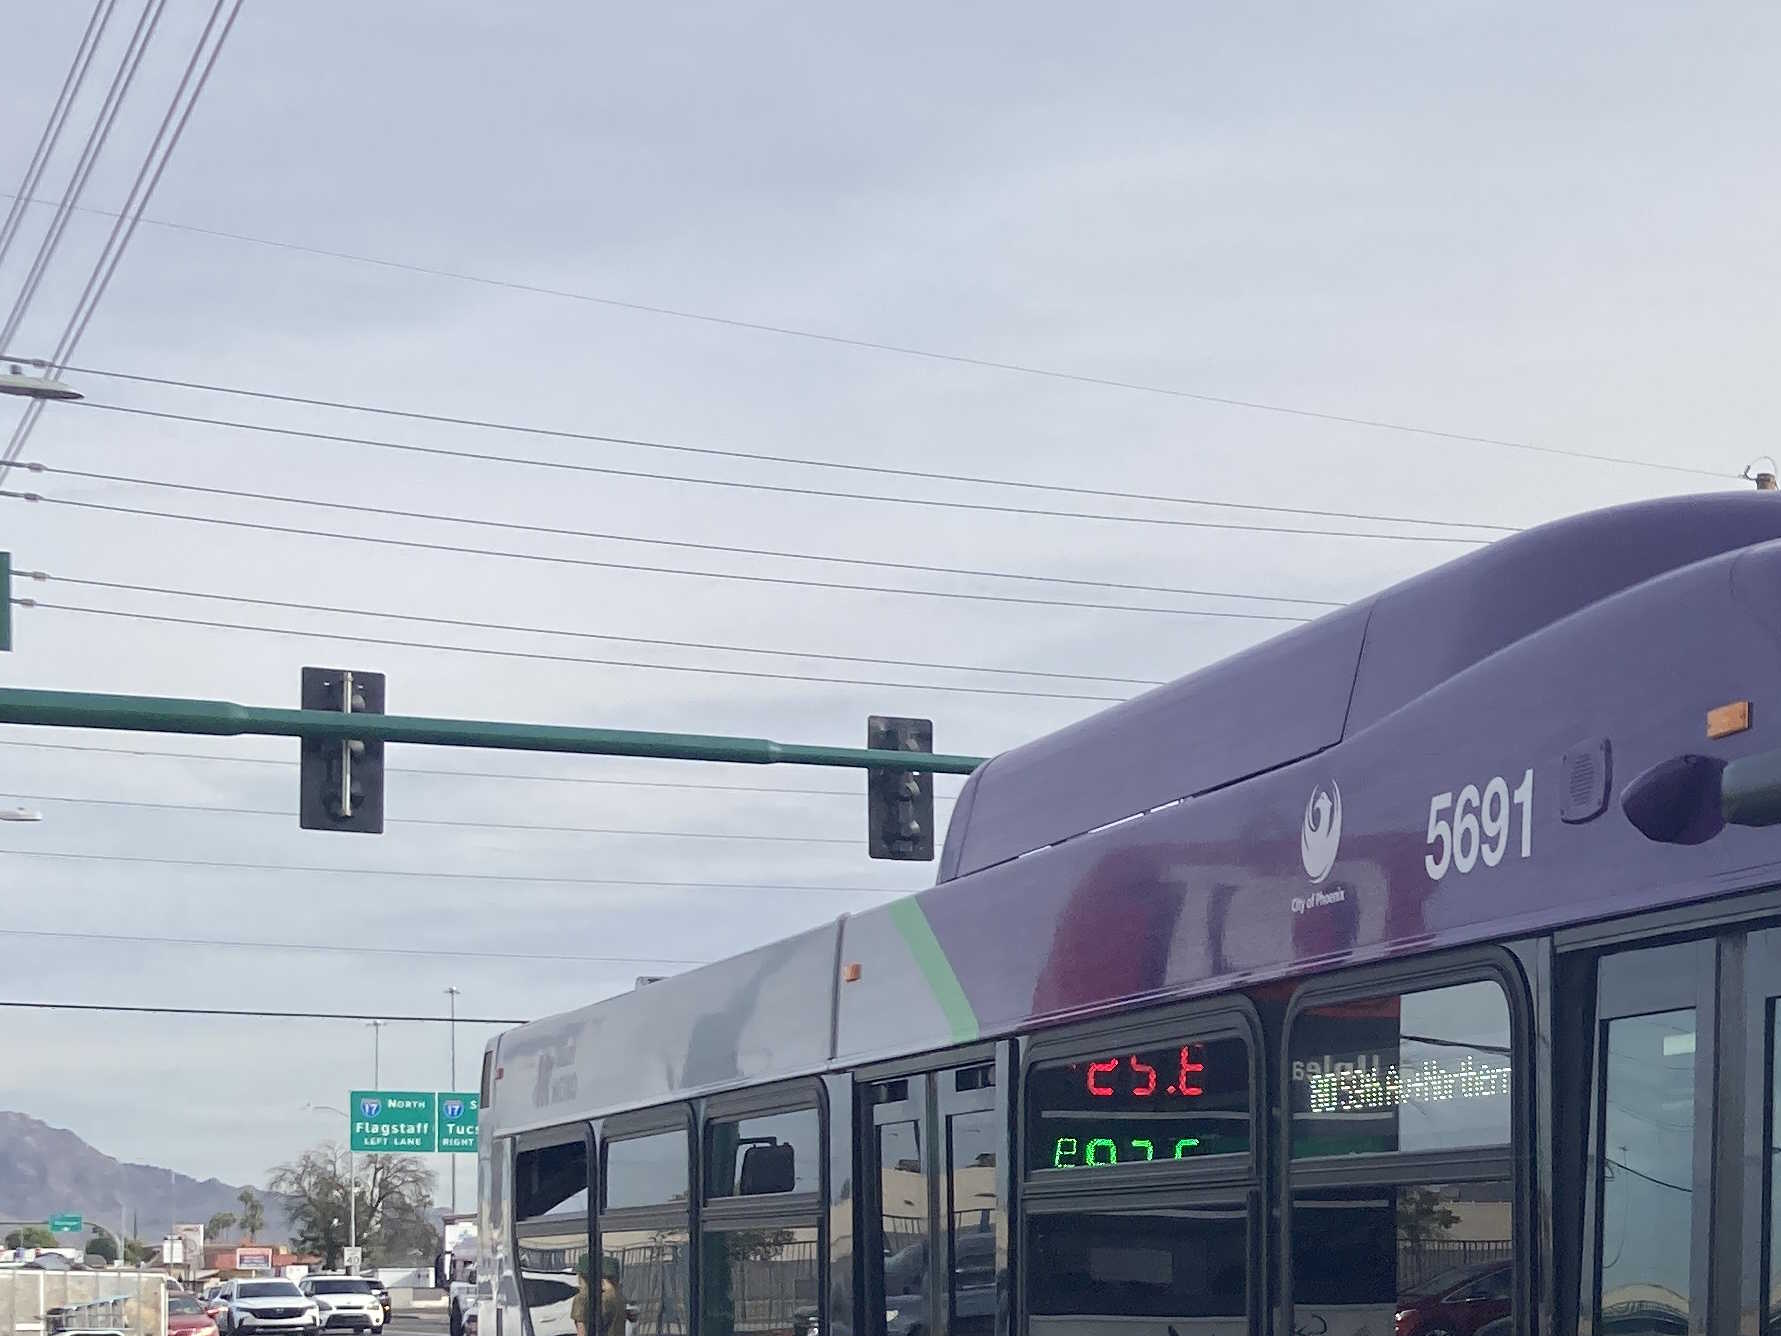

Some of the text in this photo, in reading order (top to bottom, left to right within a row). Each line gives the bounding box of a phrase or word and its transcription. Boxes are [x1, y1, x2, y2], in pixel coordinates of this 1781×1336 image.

[1424, 768, 1535, 881] 5691
[364, 1099, 426, 1116] 17 NORTH
[446, 1104, 460, 1116] 17
[355, 1121, 429, 1136] Flagstaff
[364, 1138, 422, 1146] LEFT LANE
[442, 1138, 475, 1147] RIGHT
[345, 1255, 360, 1265] 40
